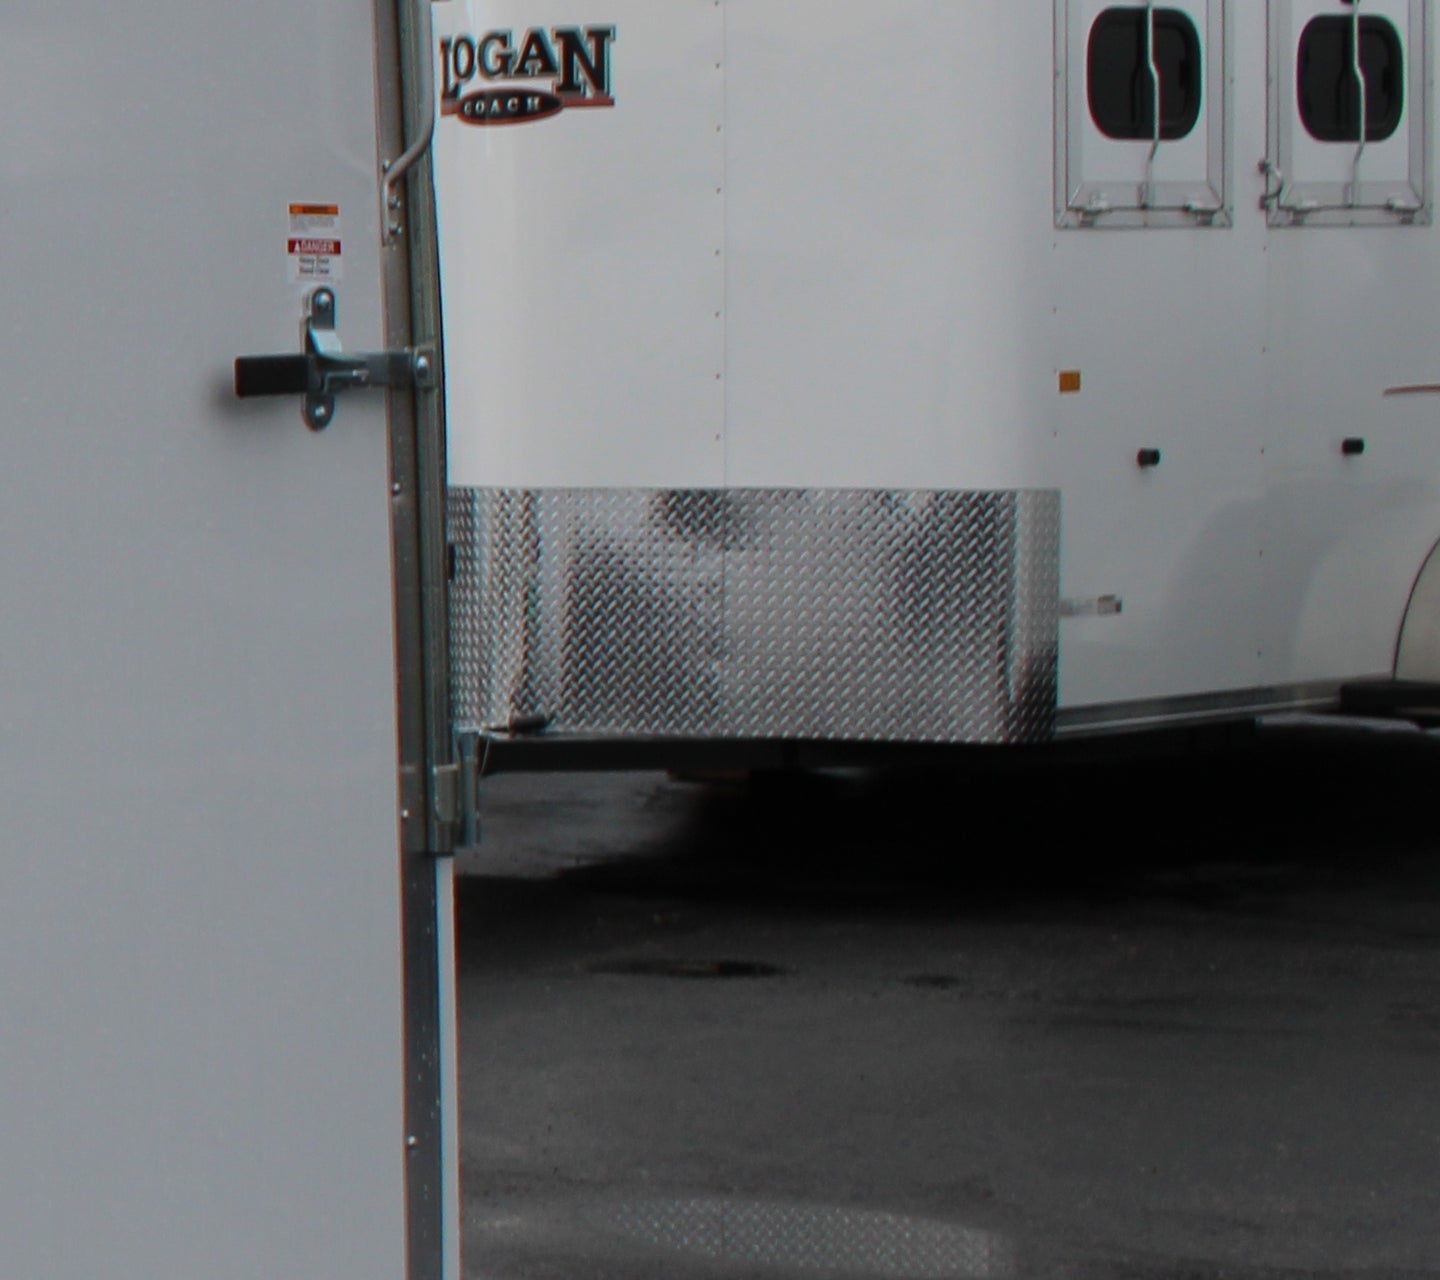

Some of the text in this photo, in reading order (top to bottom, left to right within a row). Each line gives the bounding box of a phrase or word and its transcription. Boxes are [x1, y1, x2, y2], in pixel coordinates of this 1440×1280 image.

[439, 25, 616, 99] LOGAN
[463, 97, 541, 116] COACH
[300, 240, 335, 253] DANGER
